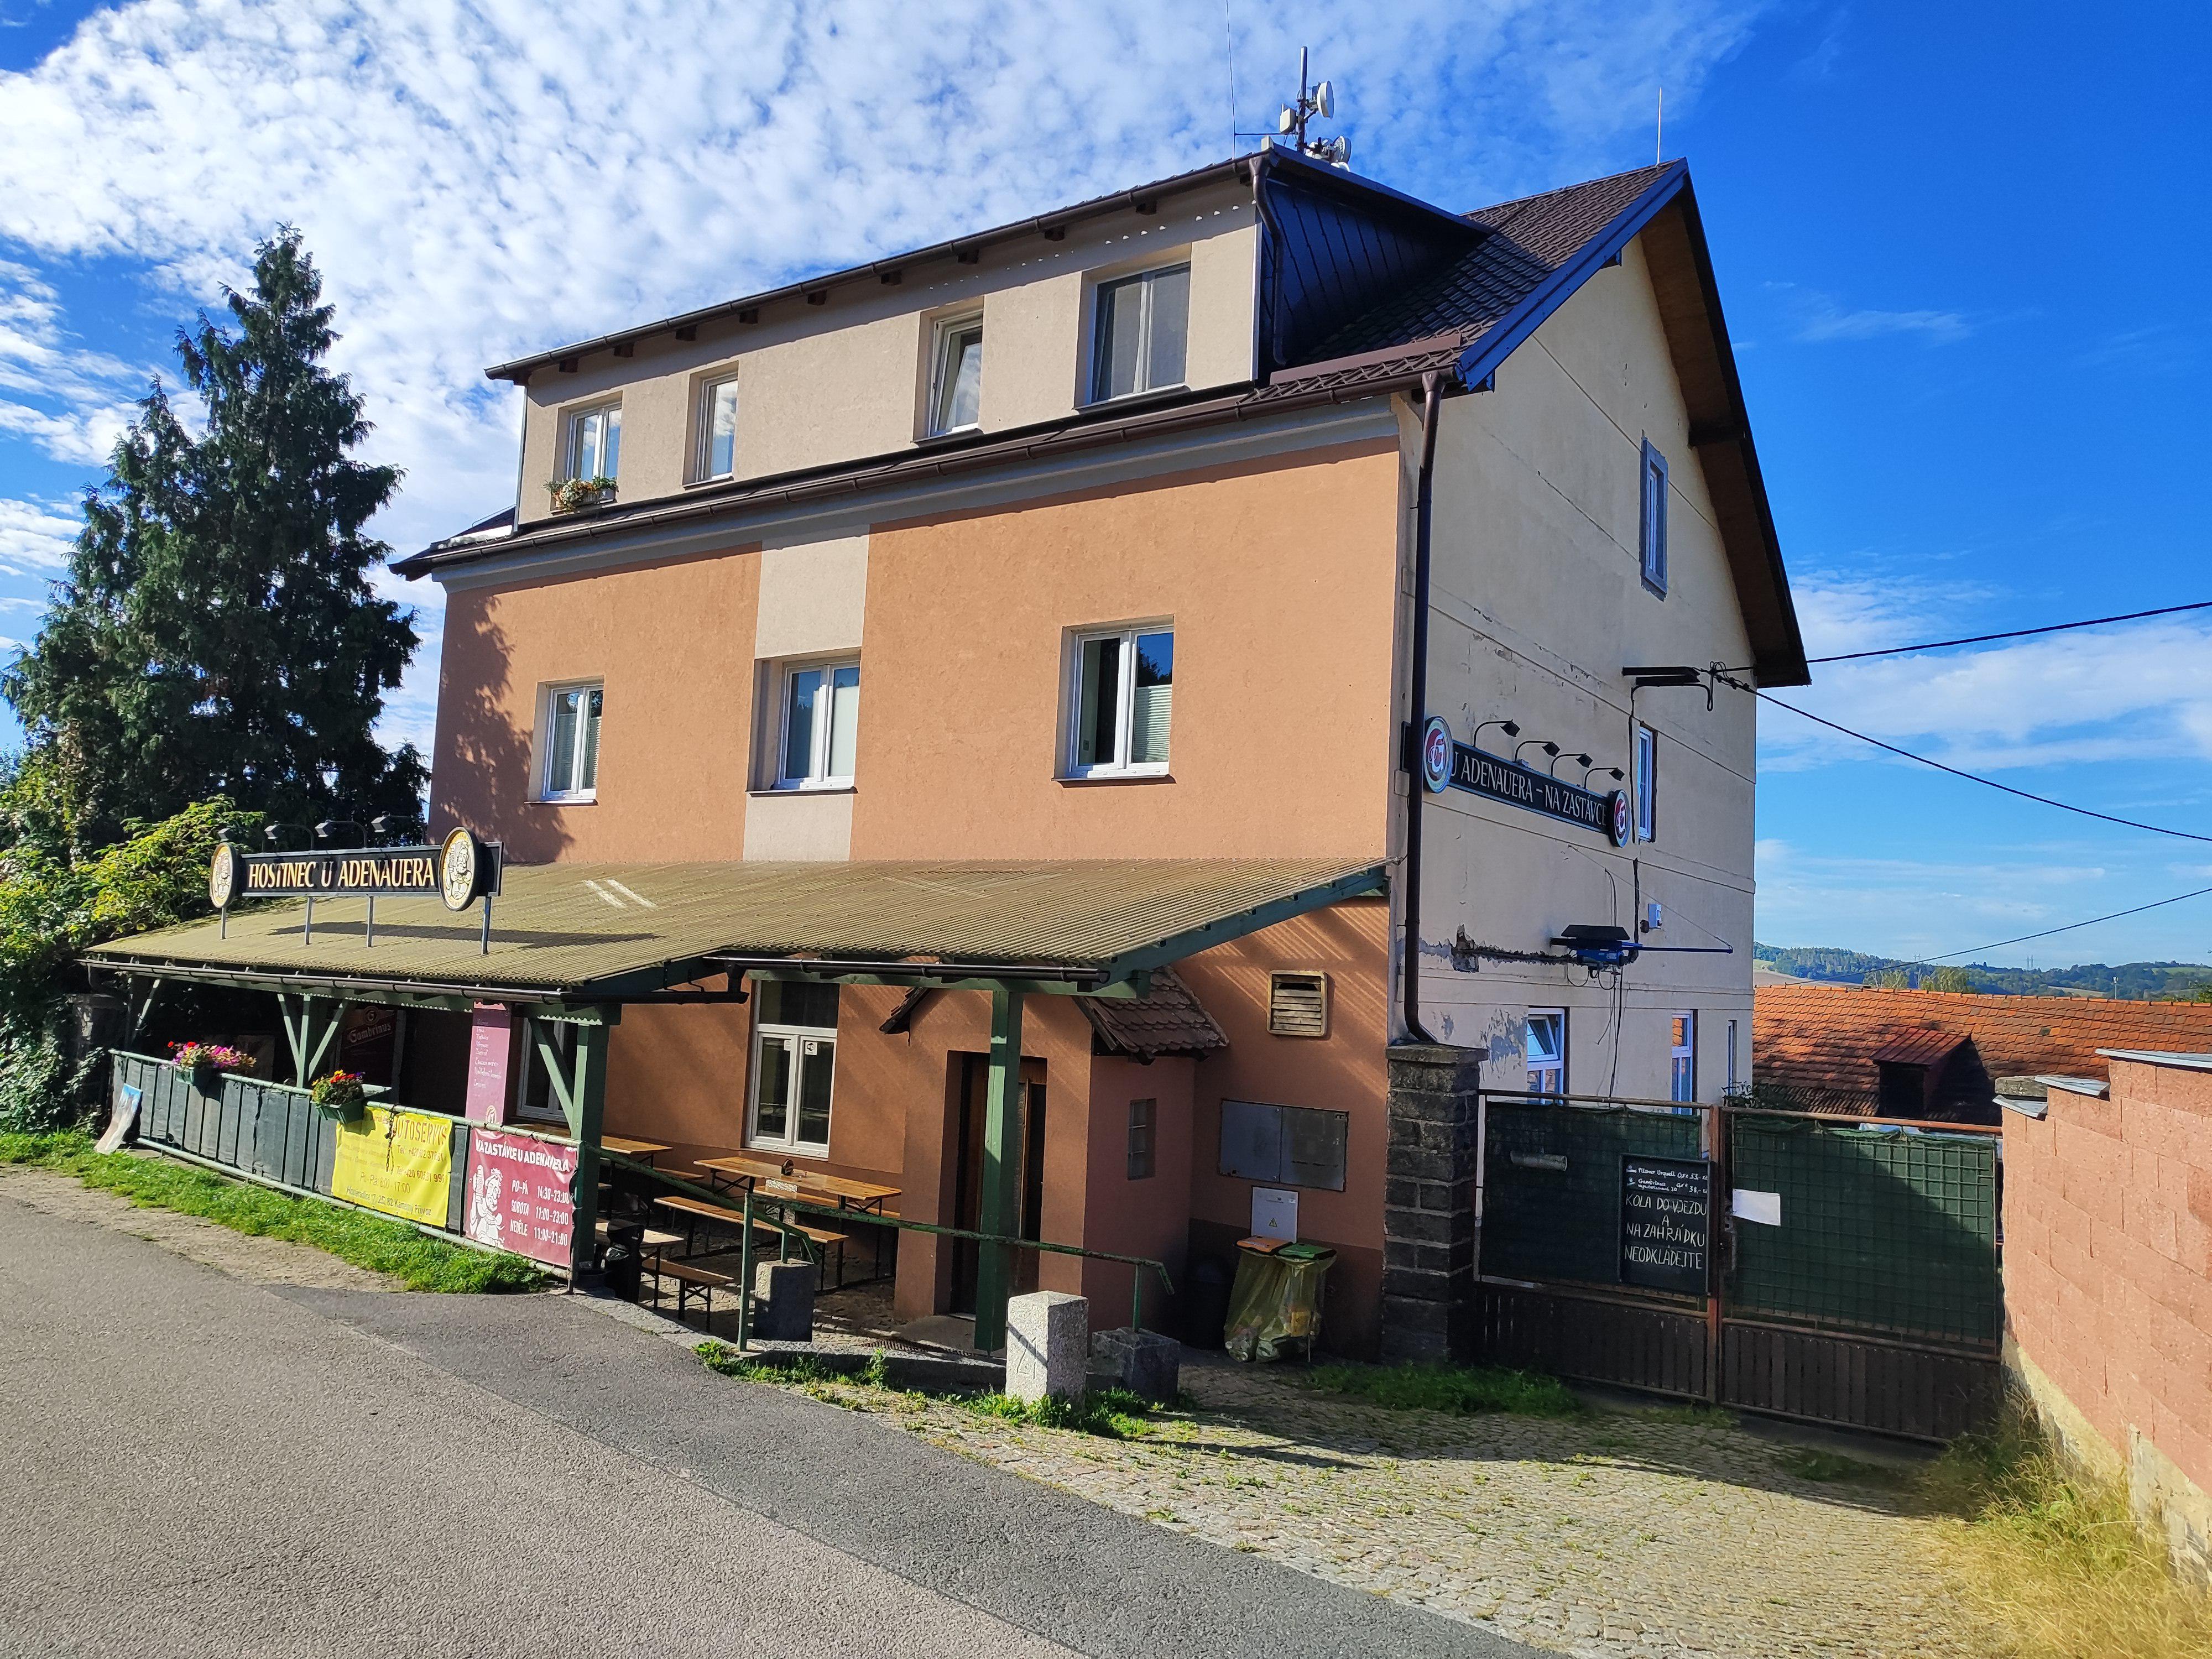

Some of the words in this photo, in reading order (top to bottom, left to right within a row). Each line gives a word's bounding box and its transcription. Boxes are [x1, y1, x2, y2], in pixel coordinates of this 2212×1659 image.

[1460, 753, 1533, 803] ADENAUERA
[1545, 784, 1560, 816] NA
[1562, 790, 1607, 826] ZASTÁVCE
[248, 861, 316, 888] HOSTINEC
[321, 860, 334, 888] U
[338, 857, 435, 887] ADENAUERA
[348, 1022, 392, 1043] Gambrinus
[394, 1119, 447, 1146] UTOSERVIS
[518, 1149, 524, 1162] U
[1637, 1178, 1666, 1187] Gambrinus
[1657, 1170, 1676, 1178] Urquell
[512, 1180, 529, 1195] PO-PÁ
[511, 1199, 530, 1216] SOBOTA
[535, 1206, 568, 1225] 11:00-23:00
[1626, 1194, 1651, 1209] KOLA
[1657, 1197, 1670, 1211] DO
[1672, 1199, 1707, 1216] VJEZDU
[1661, 1214, 1670, 1227] A
[509, 1219, 528, 1237] NEDĚLE
[534, 1226, 568, 1246] 11:00-21:00
[1626, 1222, 1641, 1238] NA
[1643, 1223, 1705, 1248] ZAHRÁDKU
